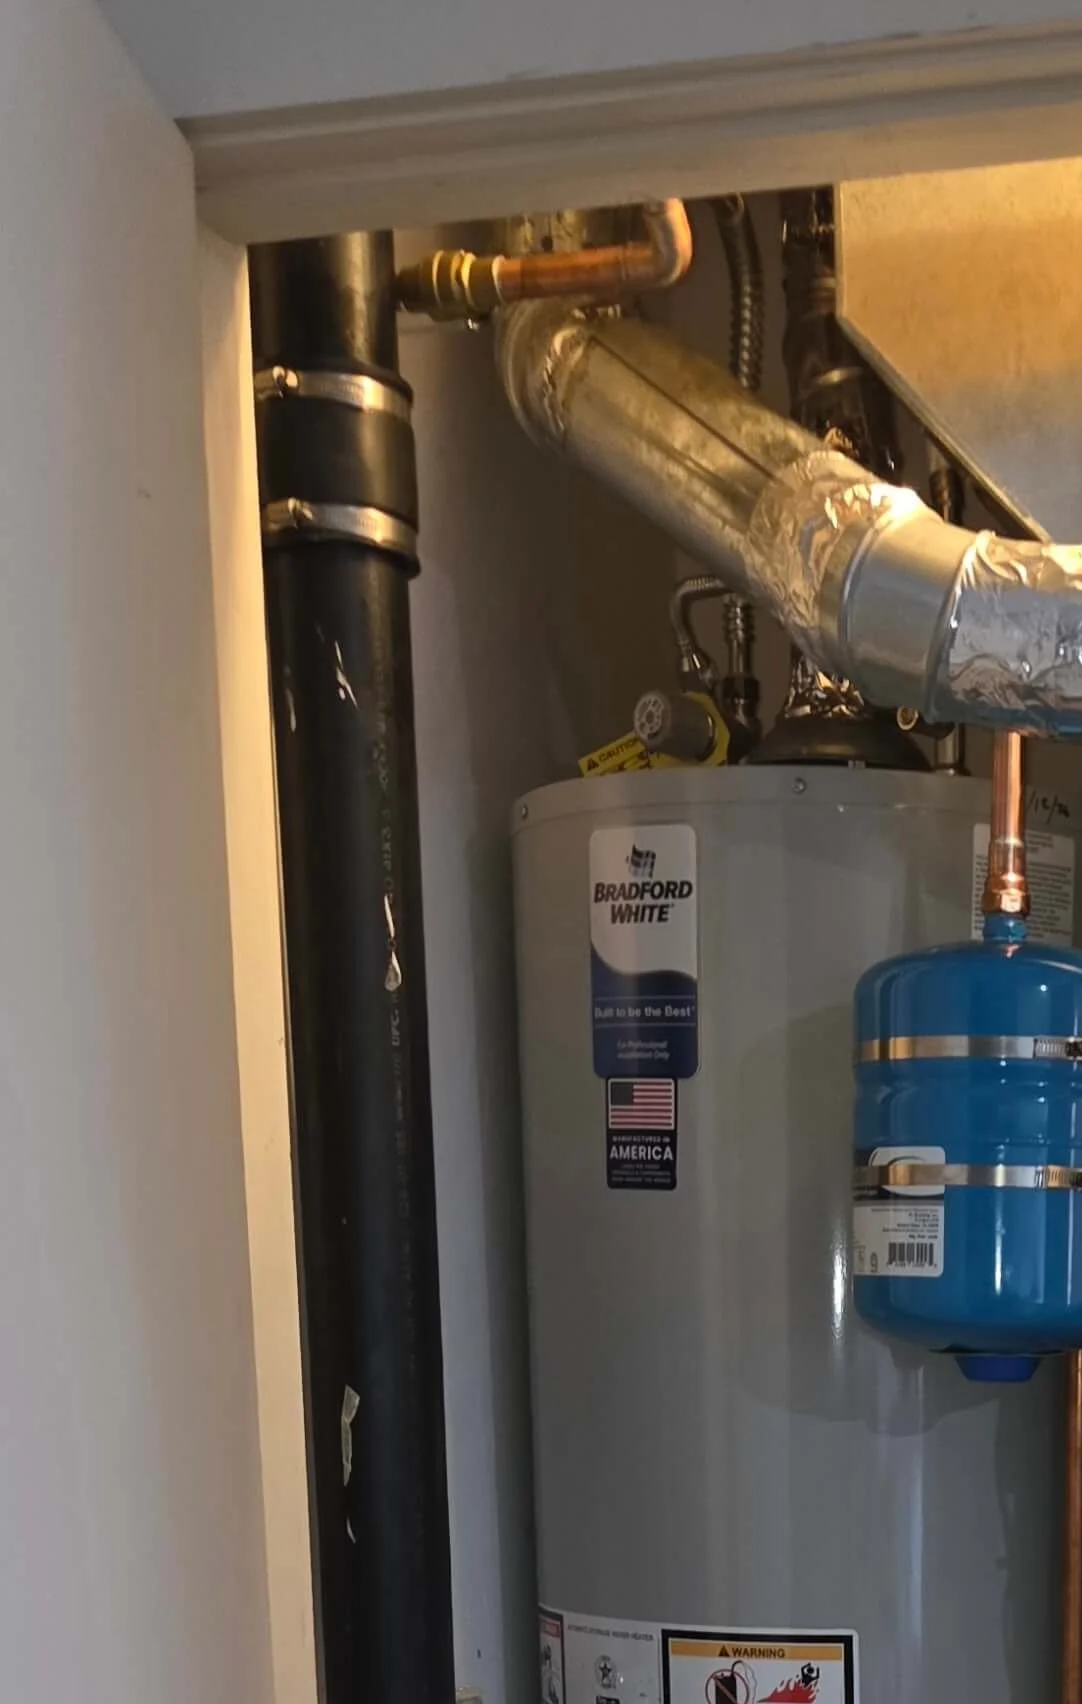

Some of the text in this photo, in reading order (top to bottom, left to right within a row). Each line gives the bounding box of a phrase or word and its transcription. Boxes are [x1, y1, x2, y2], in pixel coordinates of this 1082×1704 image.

[594, 880, 693, 903] BRADFORD
[611, 903, 670, 924] WHITE
[616, 1006, 627, 1018] to
[628, 1006, 641, 1018] be
[644, 1006, 662, 1017] the
[665, 1004, 691, 1017] Best
[609, 1145, 674, 1161] AMERICA
[732, 1647, 786, 1659] WARNING
